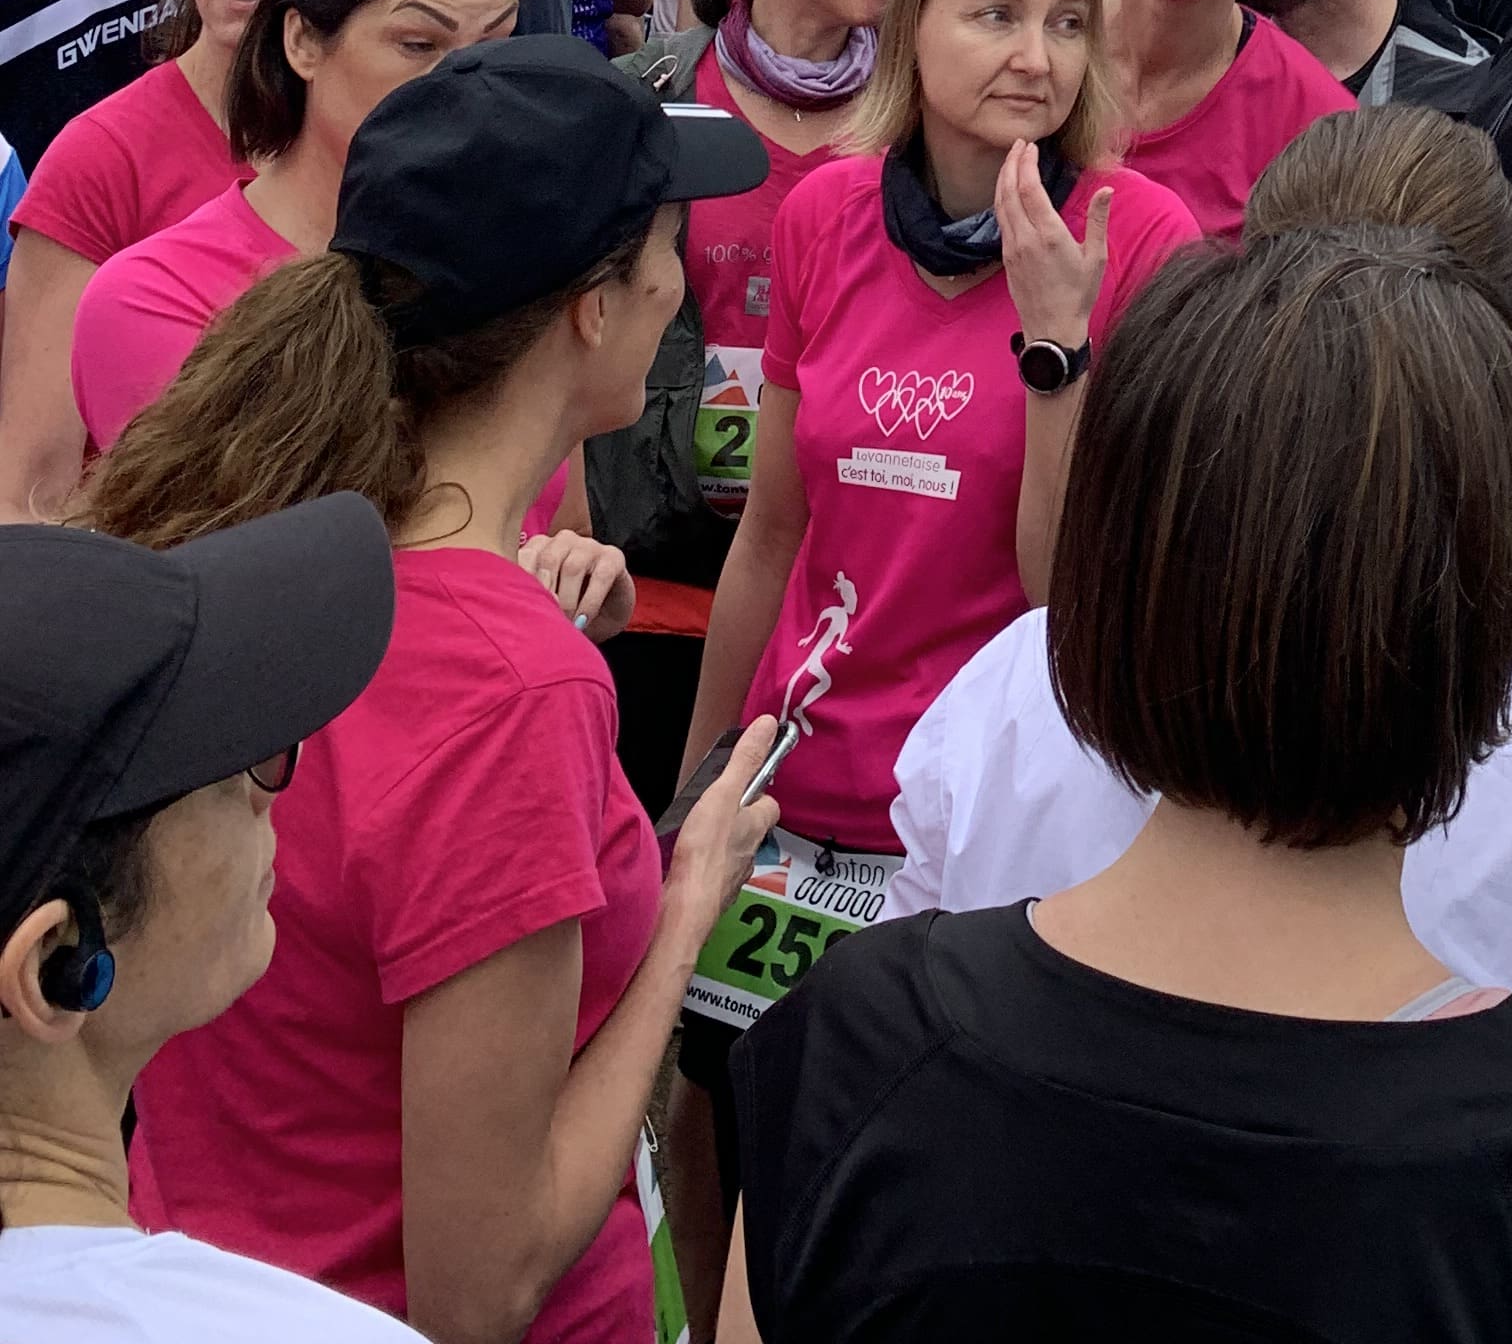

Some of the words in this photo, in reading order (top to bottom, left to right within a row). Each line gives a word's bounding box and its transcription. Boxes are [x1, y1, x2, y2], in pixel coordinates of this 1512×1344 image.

[710, 415, 751, 468] 2
[841, 465, 868, 481] c'est
[918, 478, 947, 493] nous
[823, 858, 887, 888] onton
[794, 875, 886, 922] OUTDOO
[686, 986, 761, 1021] www.tonto
